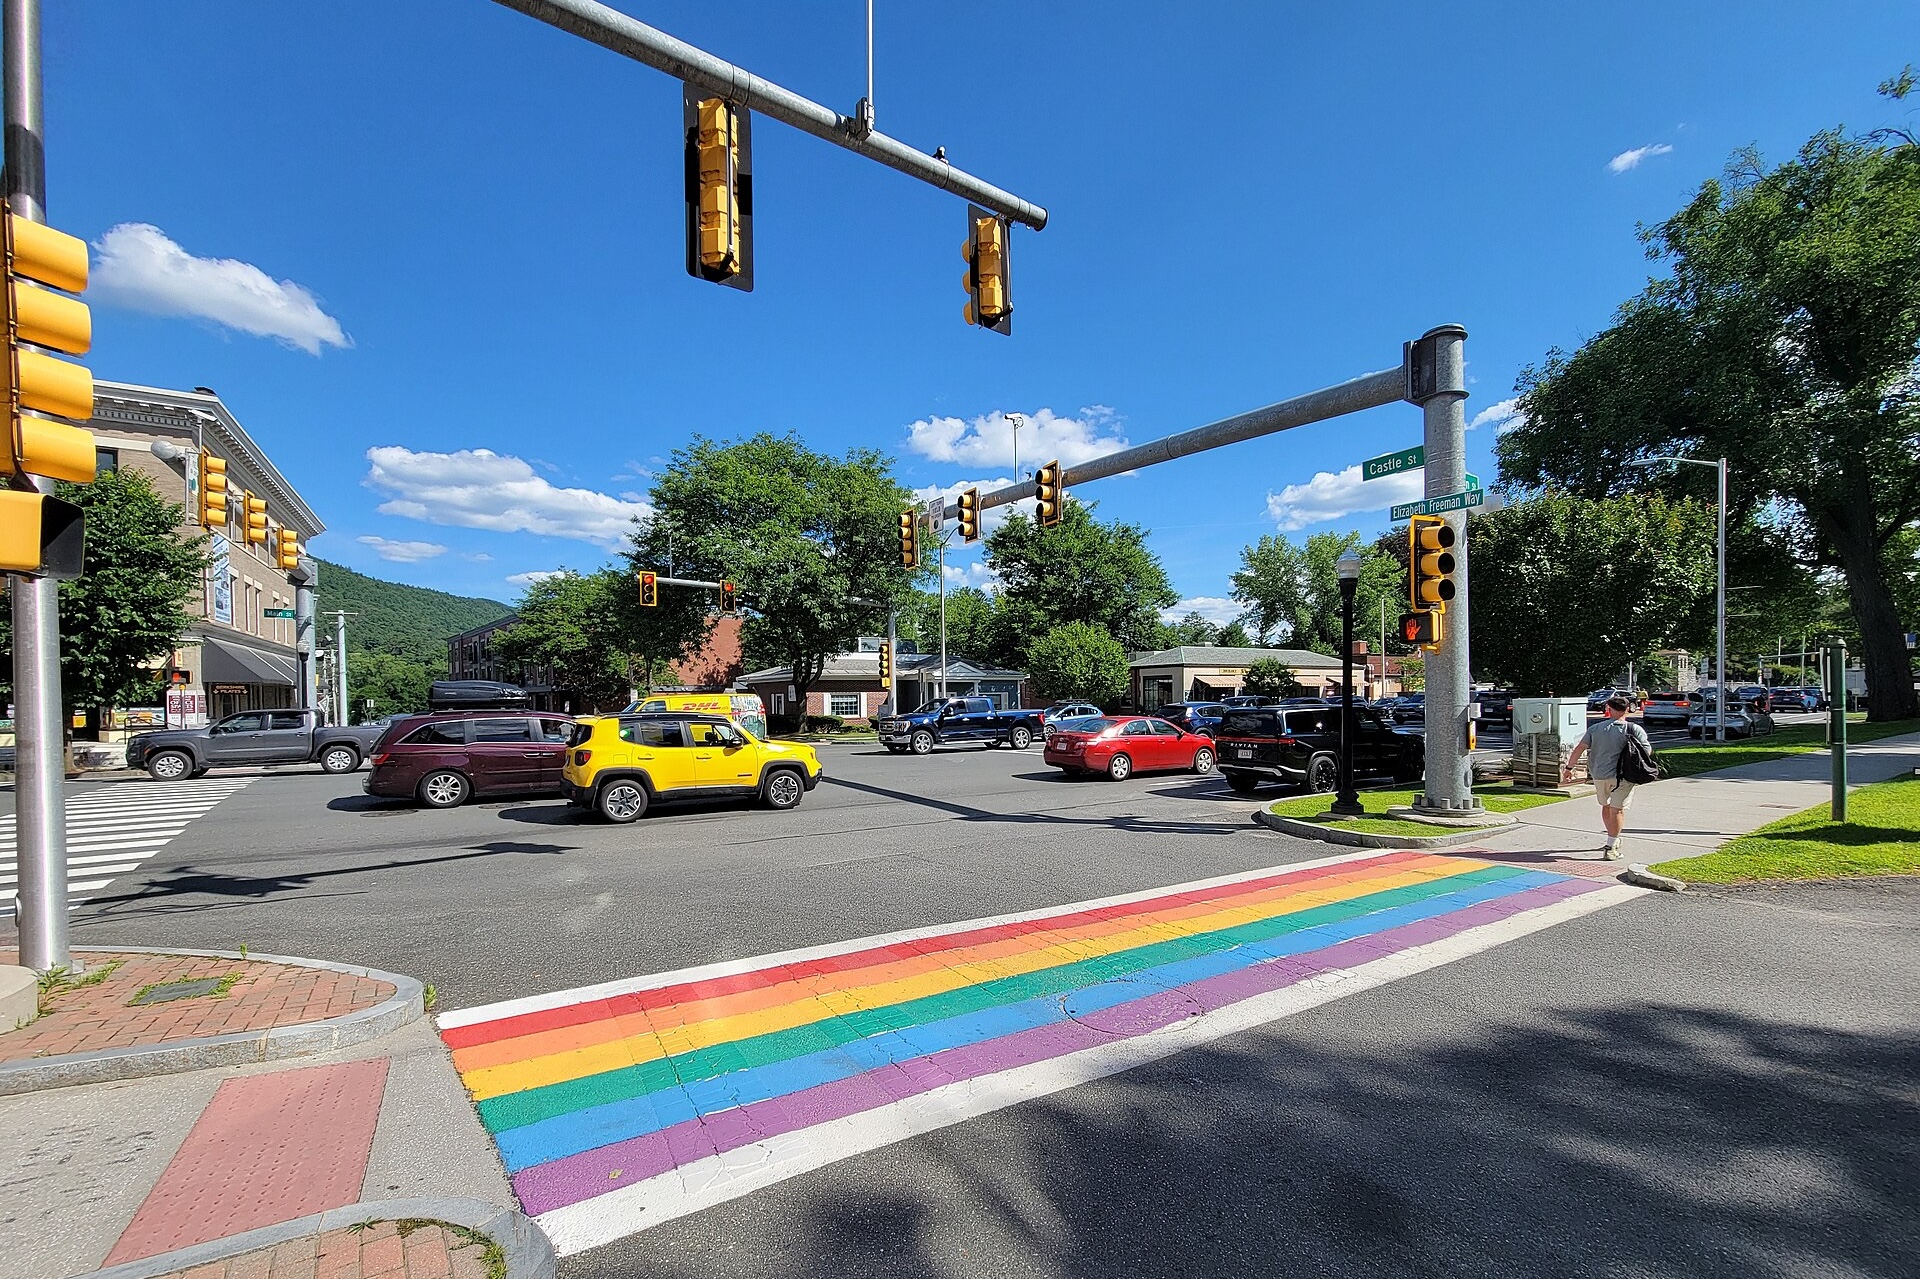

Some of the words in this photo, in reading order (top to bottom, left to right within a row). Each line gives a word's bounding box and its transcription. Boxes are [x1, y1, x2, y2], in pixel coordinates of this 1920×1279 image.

[1369, 457, 1402, 475] Castle
[1407, 455, 1417, 465] St
[1393, 502, 1426, 519] Elizabeth
[1429, 497, 1461, 510] Freeman
[1464, 492, 1481, 506] Way
[682, 702, 721, 711] DHL
